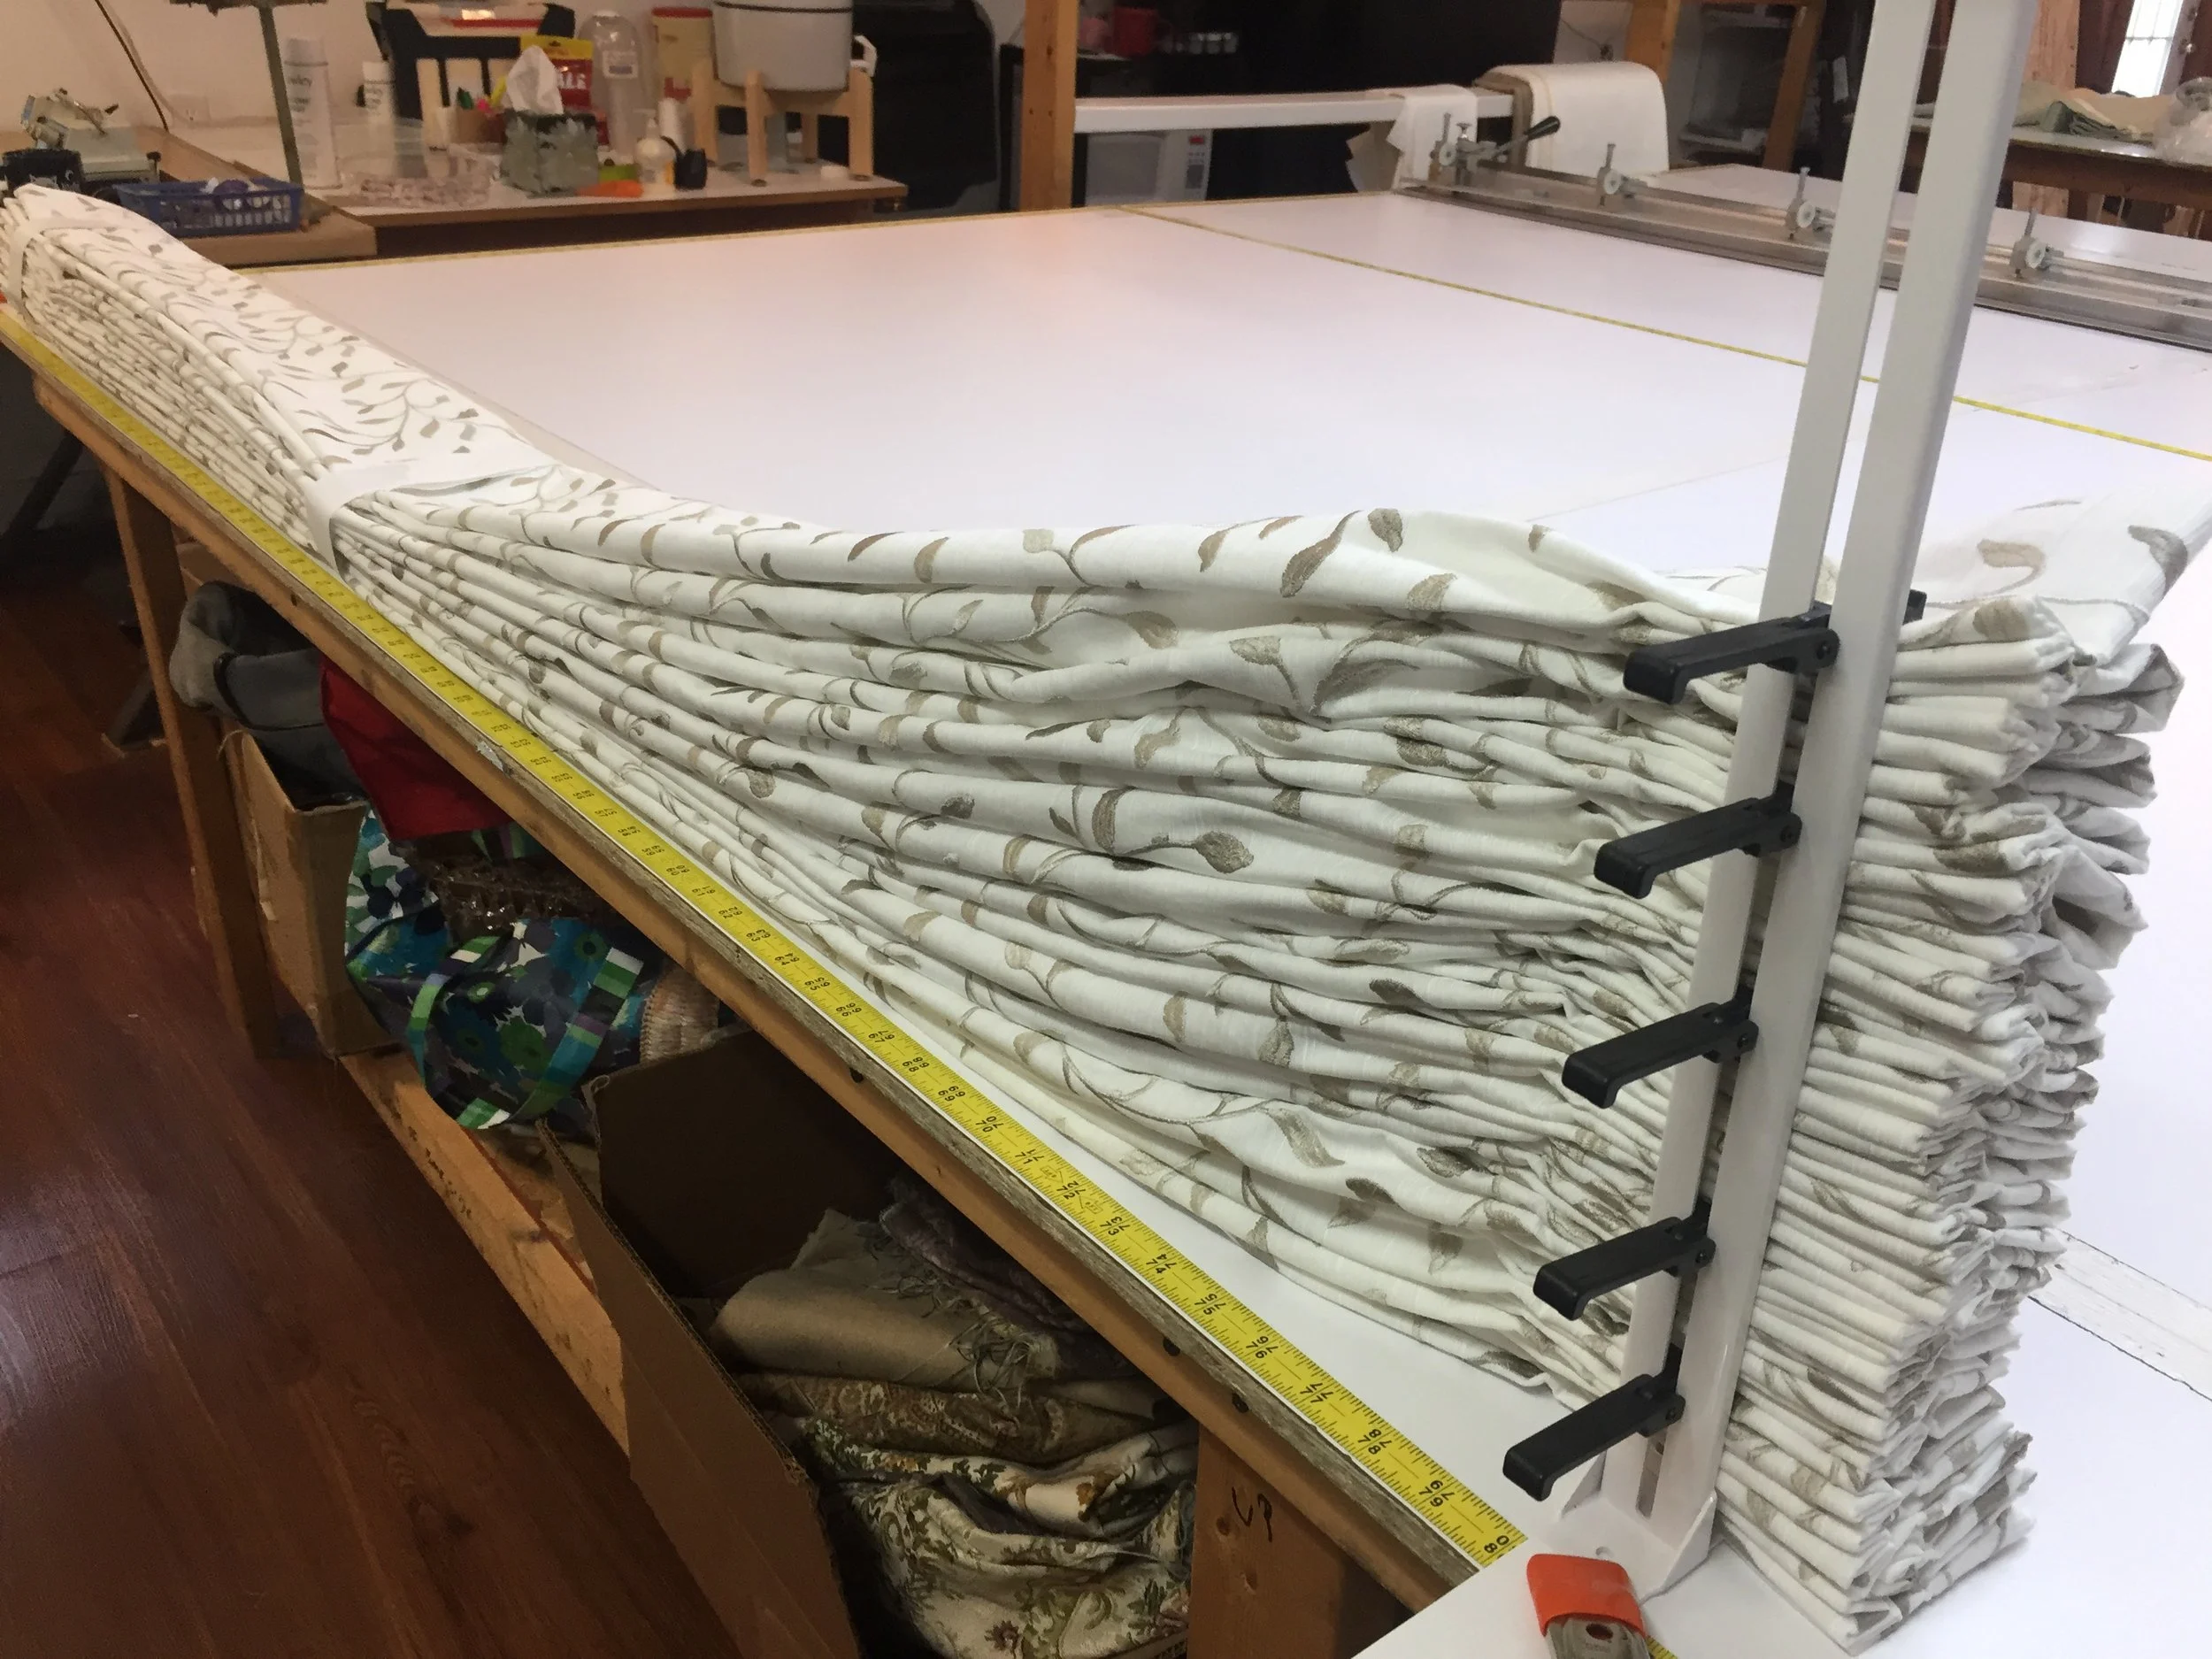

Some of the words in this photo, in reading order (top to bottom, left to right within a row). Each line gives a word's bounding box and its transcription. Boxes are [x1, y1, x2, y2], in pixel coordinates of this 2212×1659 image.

[868, 1033, 886, 1043] 67
[902, 1061, 919, 1072] 68
[938, 1089, 956, 1102] 69
[975, 1119, 994, 1133] 70
[1015, 1151, 1033, 1164] 71
[1056, 1185, 1076, 1200] 72
[1100, 1221, 1119, 1235] 73
[1146, 1258, 1166, 1273] 74
[1194, 1298, 1216, 1315] 75
[1246, 1341, 1267, 1358] 76
[1300, 1386, 1324, 1402] 77
[1357, 1434, 1381, 1455] 78
[1419, 1486, 1443, 1507] 79
